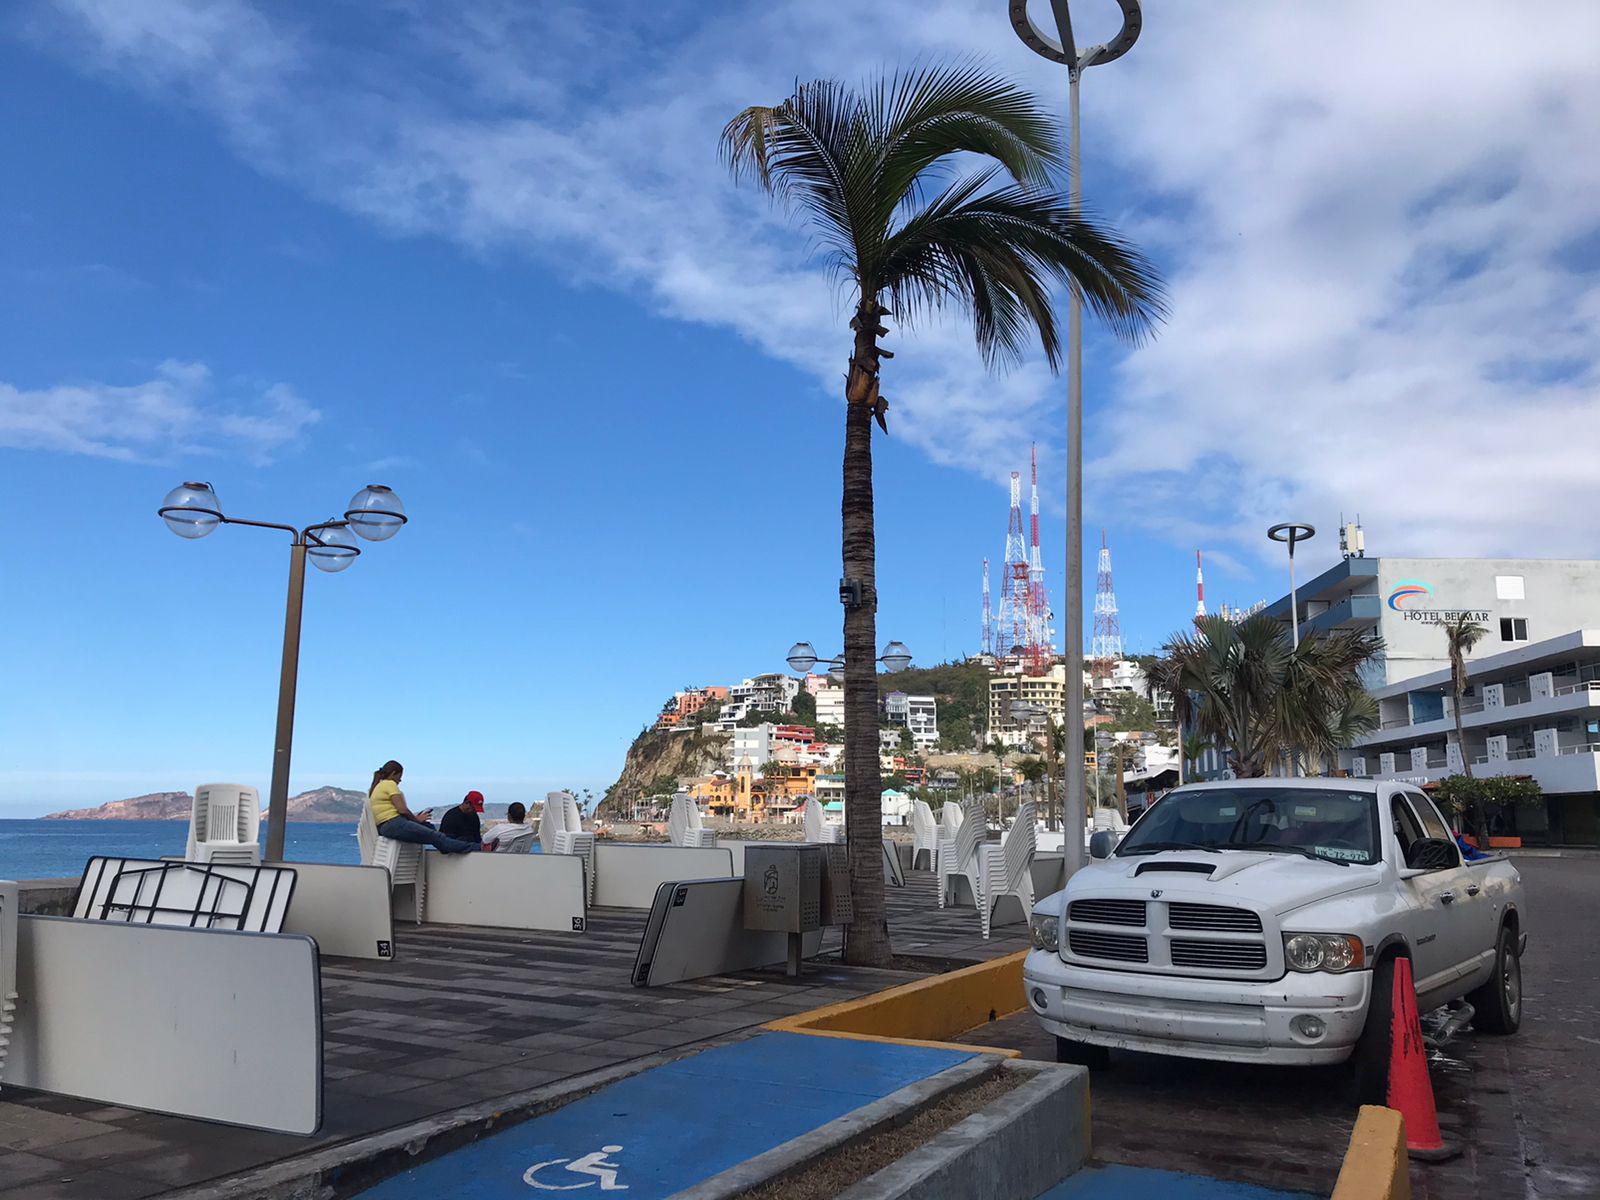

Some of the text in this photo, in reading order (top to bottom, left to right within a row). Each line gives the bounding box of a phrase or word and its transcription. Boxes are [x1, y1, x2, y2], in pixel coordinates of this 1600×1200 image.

[1404, 612, 1490, 621] HOTEL BELMAR
[379, 942, 389, 956] 34
